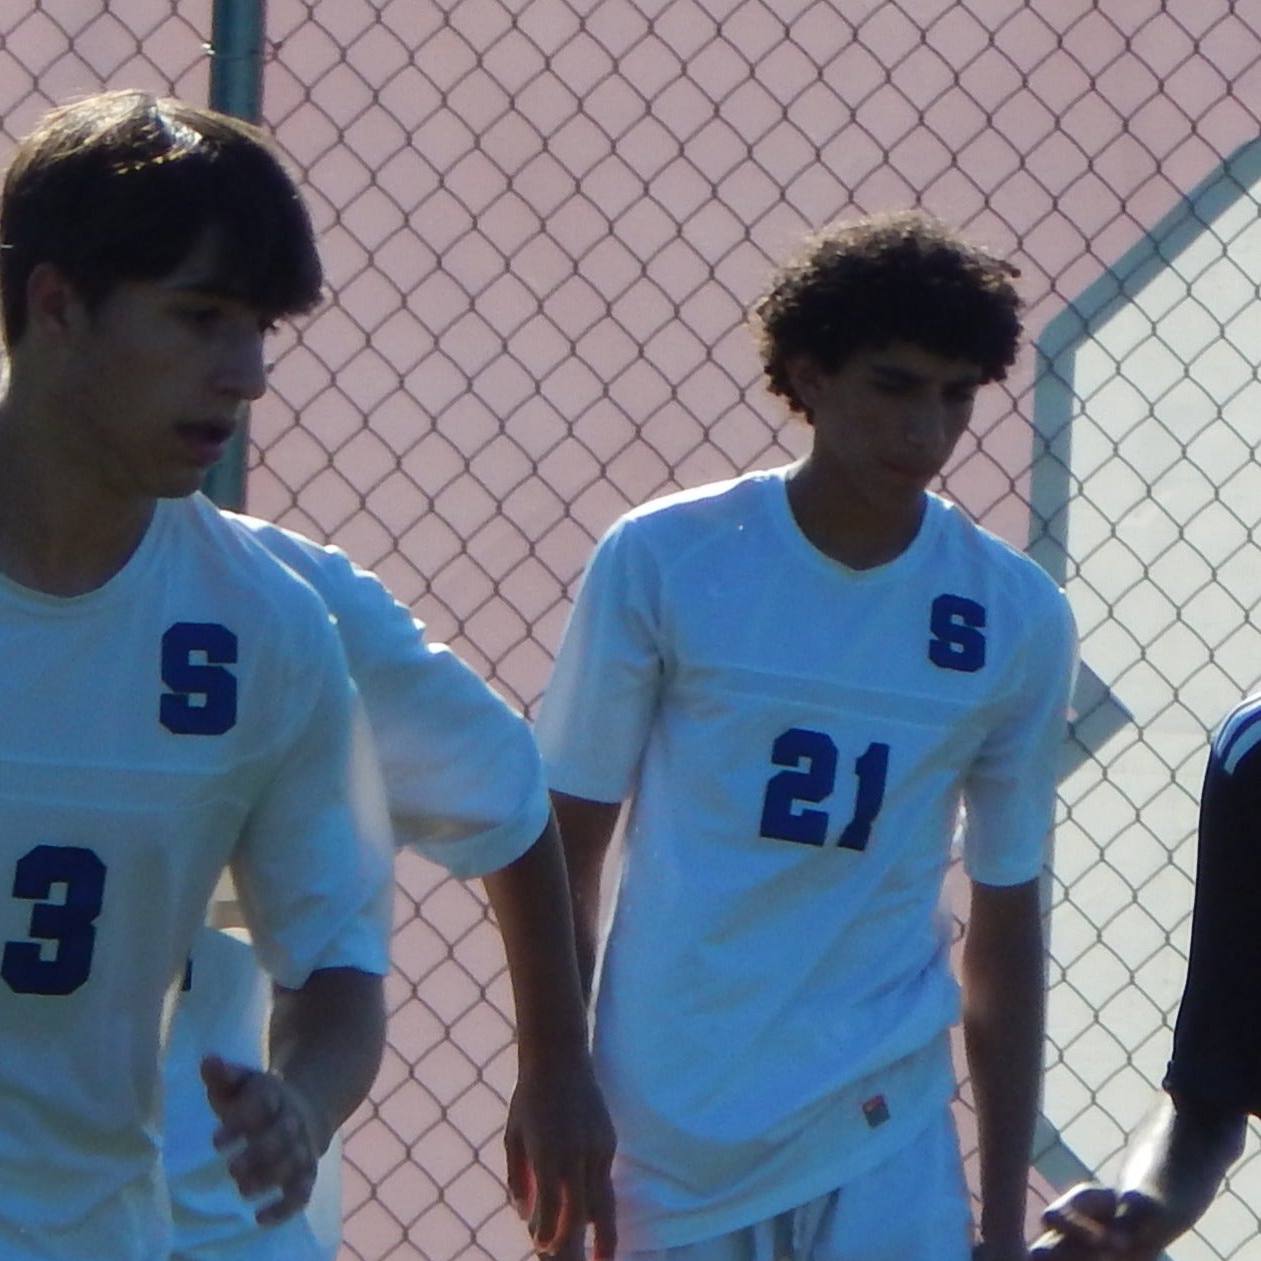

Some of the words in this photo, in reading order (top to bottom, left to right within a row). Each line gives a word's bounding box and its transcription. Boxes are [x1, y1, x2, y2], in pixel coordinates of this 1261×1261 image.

[158, 621, 239, 736] S
[928, 593, 987, 673] S
[759, 728, 891, 852] 21
